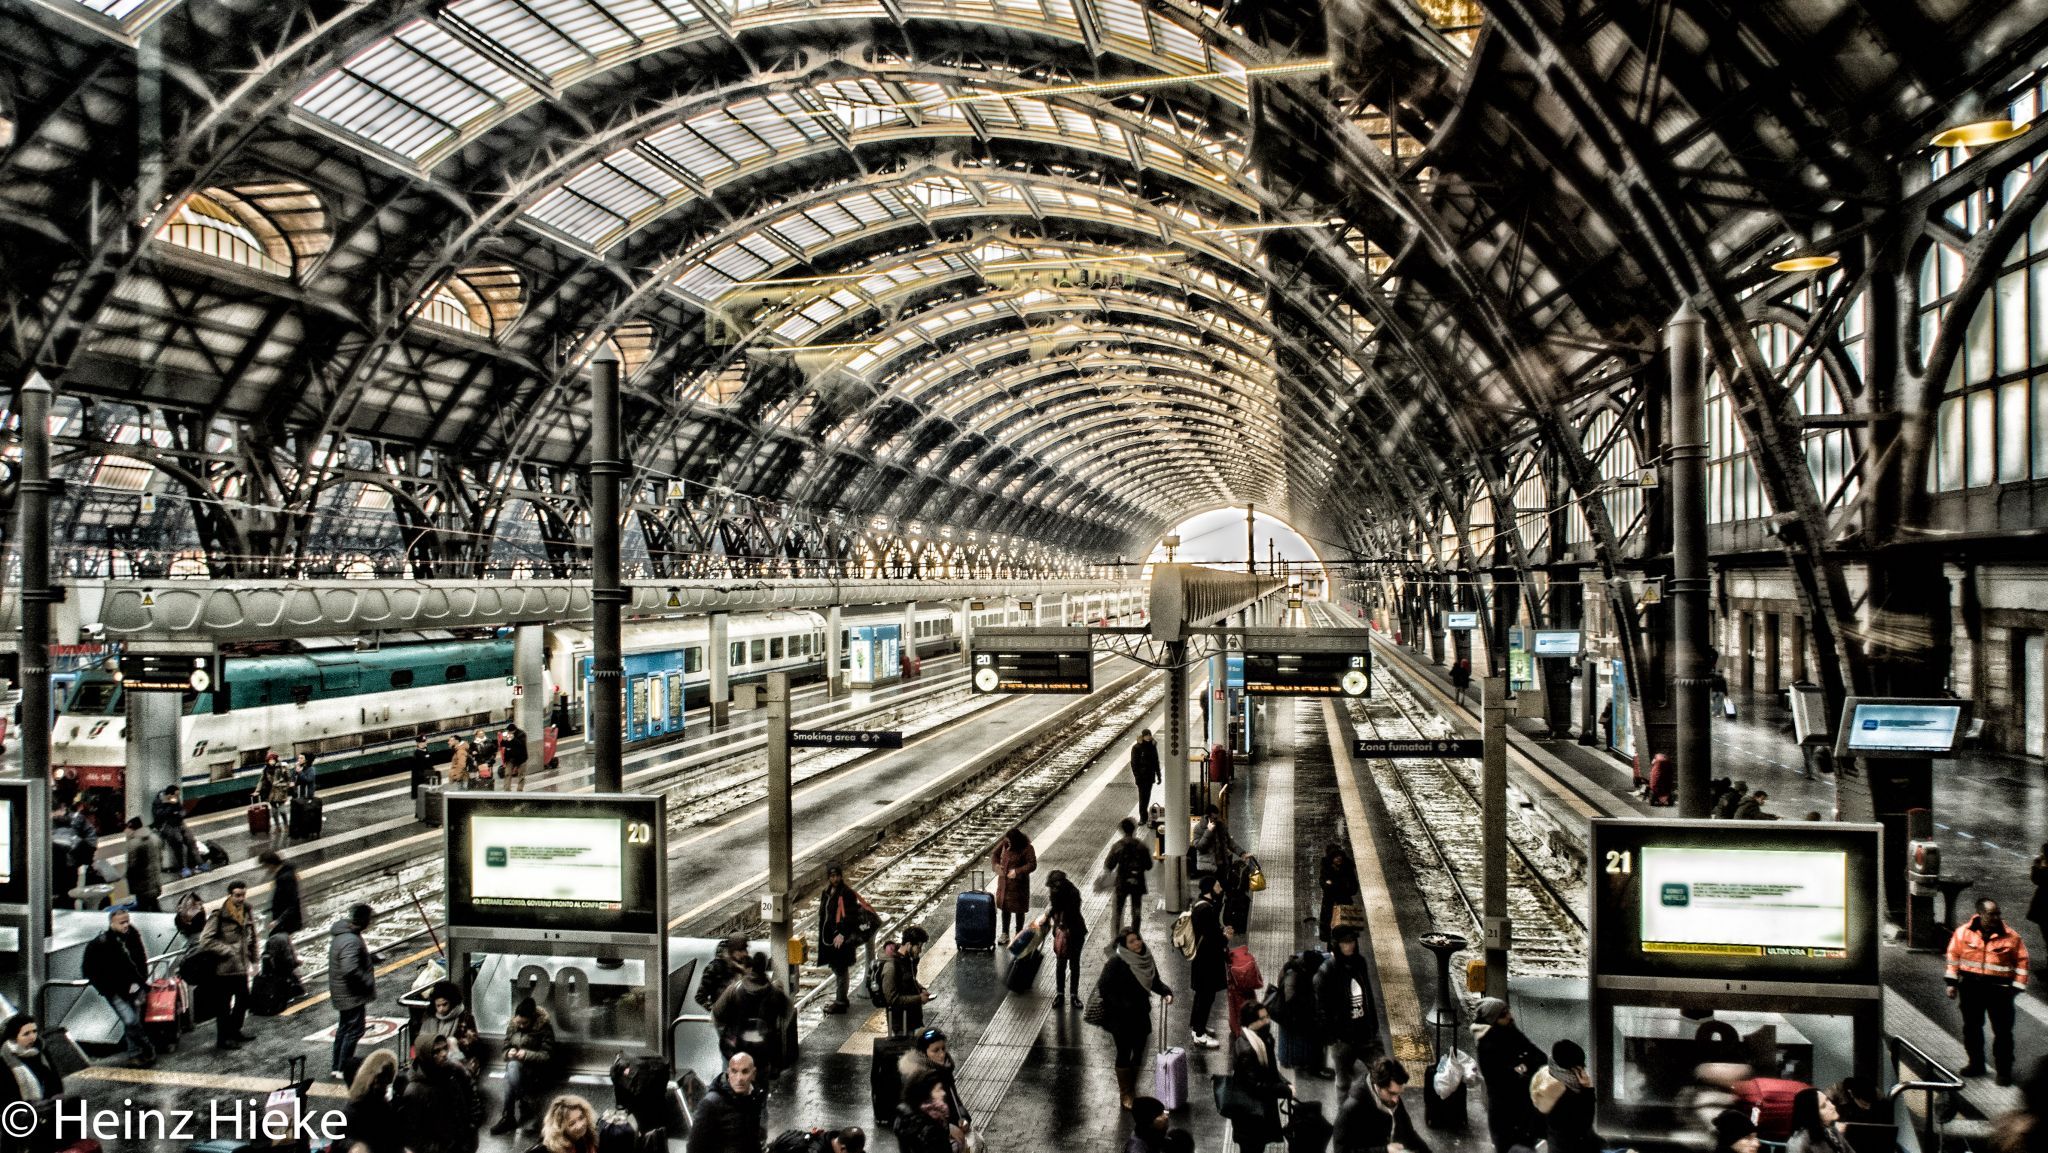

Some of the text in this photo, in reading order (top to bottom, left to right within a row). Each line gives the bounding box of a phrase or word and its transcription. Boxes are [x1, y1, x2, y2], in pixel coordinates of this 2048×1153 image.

[976, 654, 991, 665] 20
[1351, 656, 1364, 668] 21
[793, 732, 857, 743] Smoking area
[1359, 741, 1432, 752] Zona fumatori
[628, 823, 650, 844] 20
[1605, 849, 1632, 874] 21
[527, 899, 552, 907] GOVERNO
[552, 900, 574, 908] PRONTO
[762, 902, 773, 911] 20
[1487, 928, 1498, 938] 21
